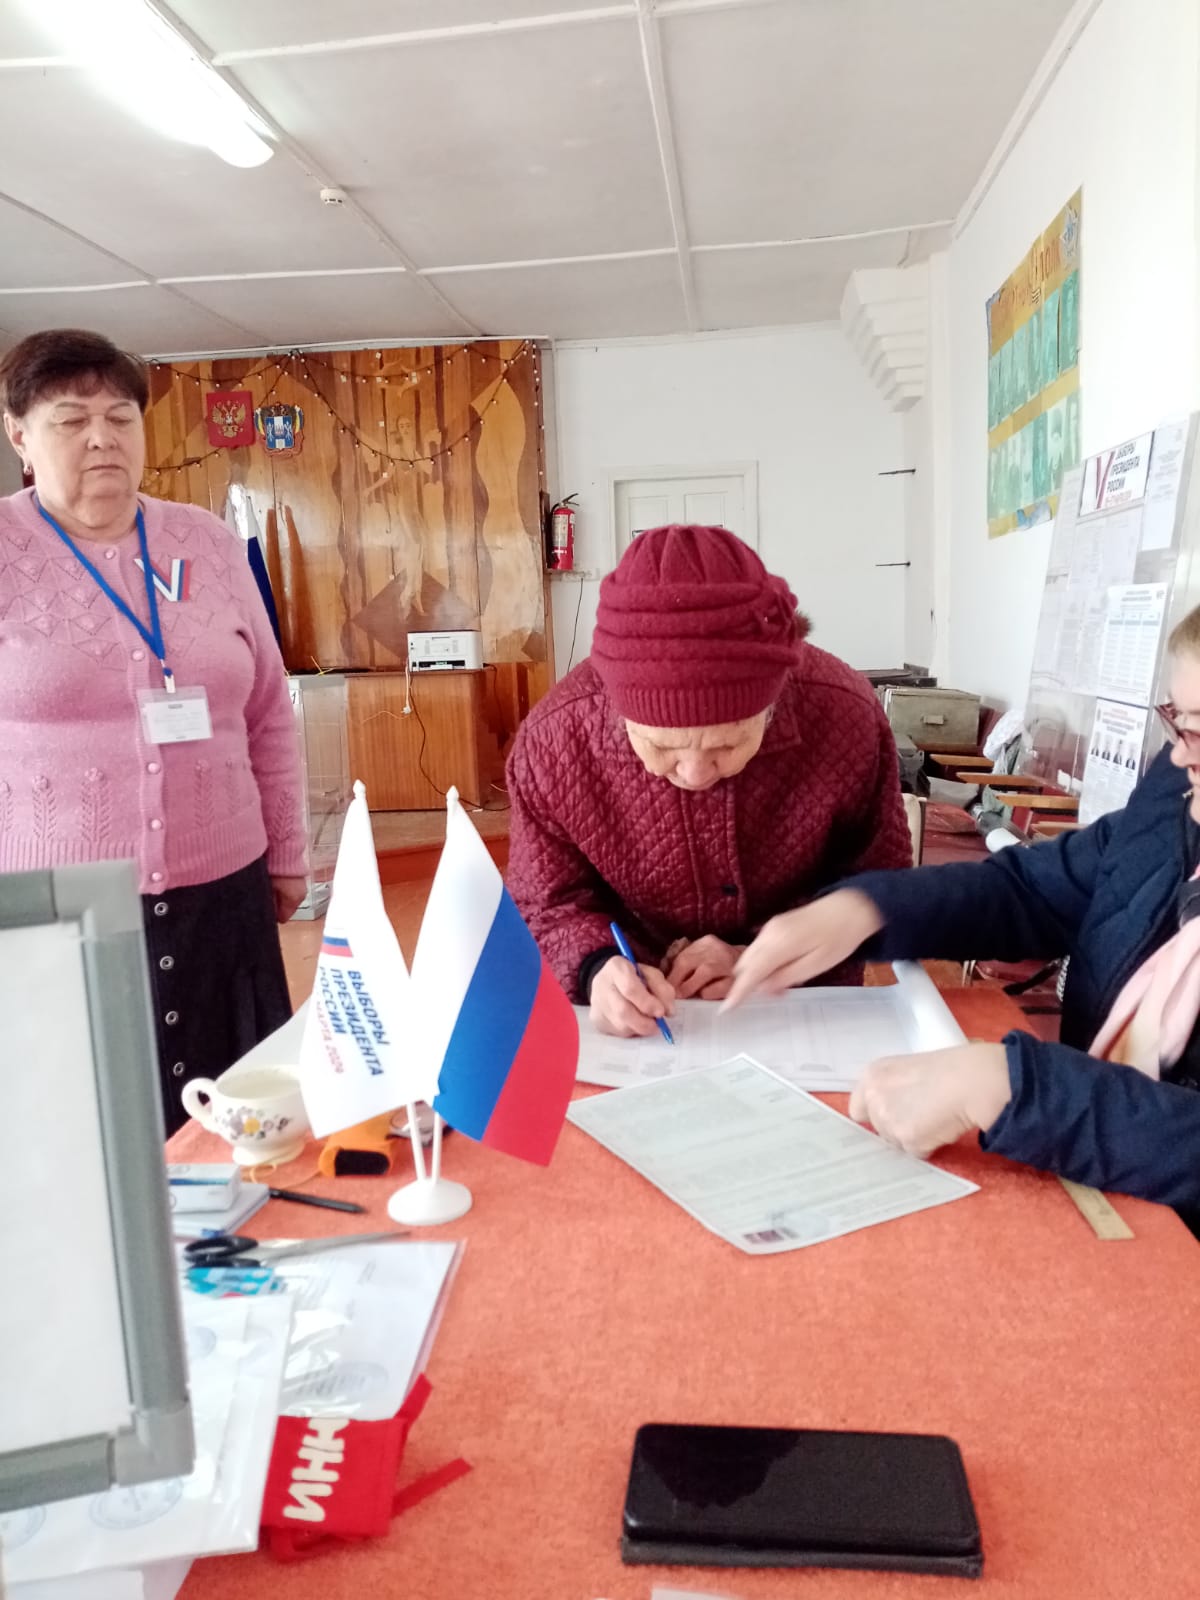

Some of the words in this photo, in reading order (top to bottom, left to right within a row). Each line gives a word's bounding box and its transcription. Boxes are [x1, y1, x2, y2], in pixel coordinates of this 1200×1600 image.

[319, 966, 347, 1034] РОССИИ
[330, 968, 384, 1076] ПРЕЗИДЕНТА
[347, 970, 390, 1045] ВЫБОРЫ
